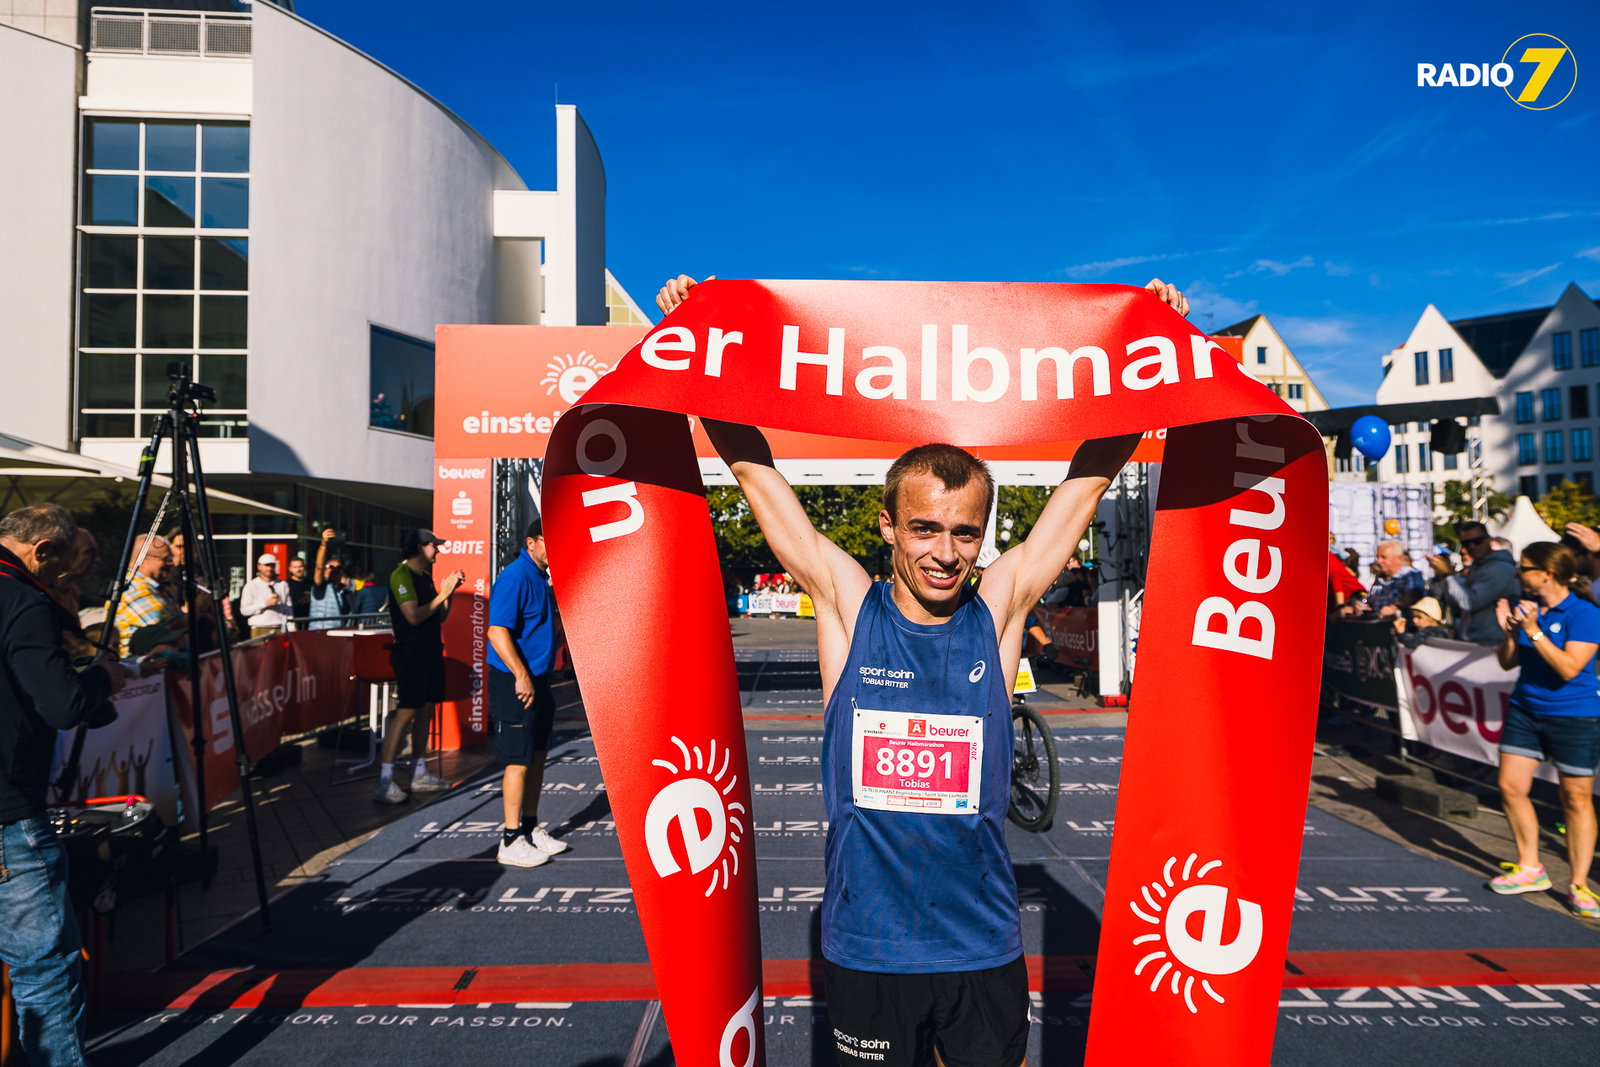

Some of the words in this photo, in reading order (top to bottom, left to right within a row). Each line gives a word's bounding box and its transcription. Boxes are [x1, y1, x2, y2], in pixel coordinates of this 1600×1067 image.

[779, 322, 1228, 402] Halbmar
[439, 466, 486, 479] beurer
[1192, 414, 1286, 660] Beur
[452, 541, 485, 554] BITE
[469, 578, 485, 732] einsteinmarathon.de
[859, 666, 886, 677] sport
[887, 669, 915, 680] sohn
[862, 677, 884, 686] TOBIAS
[884, 679, 909, 688] RITTER
[1404, 654, 1508, 744] beu
[929, 724, 969, 737] beurer
[907, 740, 945, 748] Halbmarathon
[876, 747, 953, 779] 8891
[754, 783, 823, 791] UZI
[899, 779, 931, 789] Tobias
[753, 821, 830, 831] UZI
[498, 887, 632, 903] UTZ
[1316, 886, 1470, 903] UTZ
[470, 905, 518, 913] OUR
[526, 905, 635, 913] PASSION.
[1329, 905, 1379, 913] OUR
[356, 1014, 419, 1026] OUR
[430, 1016, 574, 1028] PASSION.
[1285, 1014, 1373, 1027] YOUR
[1381, 1015, 1499, 1028] FLOOR.
[1506, 1015, 1575, 1027] OUR
[833, 1028, 859, 1047] sport
[860, 1039, 890, 1050] sohn
[836, 1042, 858, 1057] TOBIAS
[859, 1051, 885, 1061] RITTER
